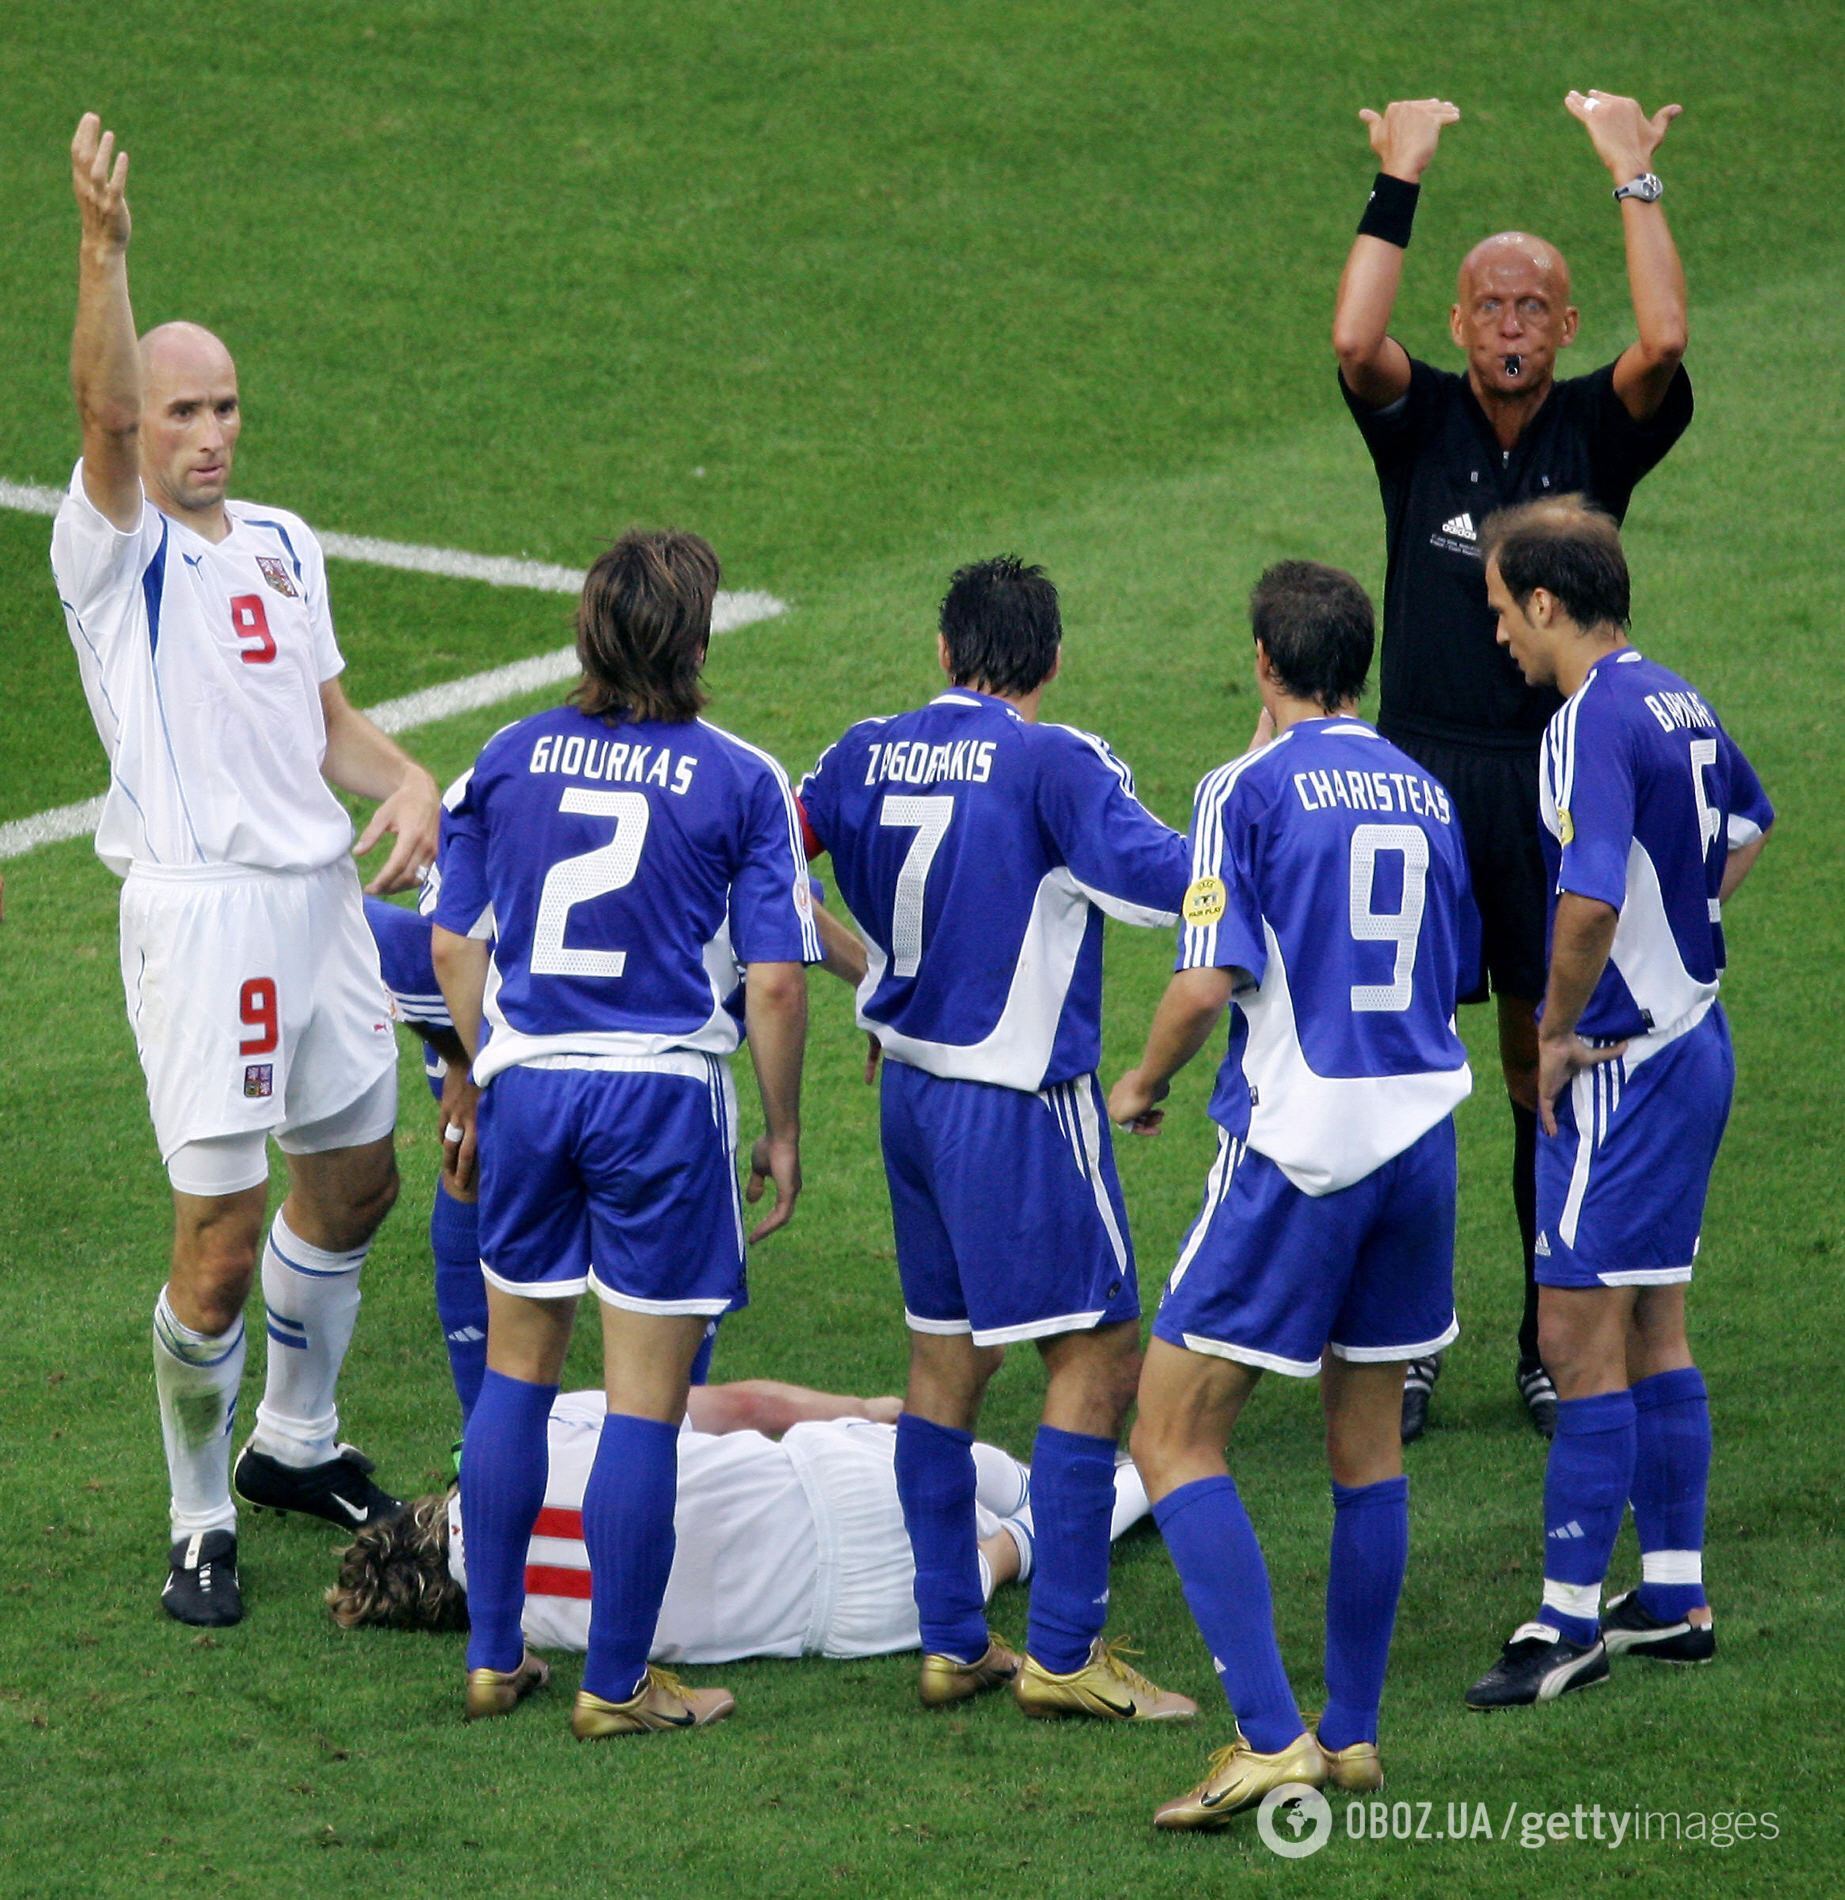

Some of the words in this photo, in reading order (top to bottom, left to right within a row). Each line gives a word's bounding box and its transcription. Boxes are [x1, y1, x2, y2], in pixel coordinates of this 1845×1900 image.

[1442, 523, 1477, 541] adidas
[229, 593, 278, 664] 9
[529, 735, 698, 796] GIOURKAS
[1292, 769, 1451, 824] CHARISTEAS
[530, 786, 650, 978] 2
[880, 795, 954, 977] 7
[1350, 824, 1430, 1012] 9
[239, 976, 280, 1057] 9
